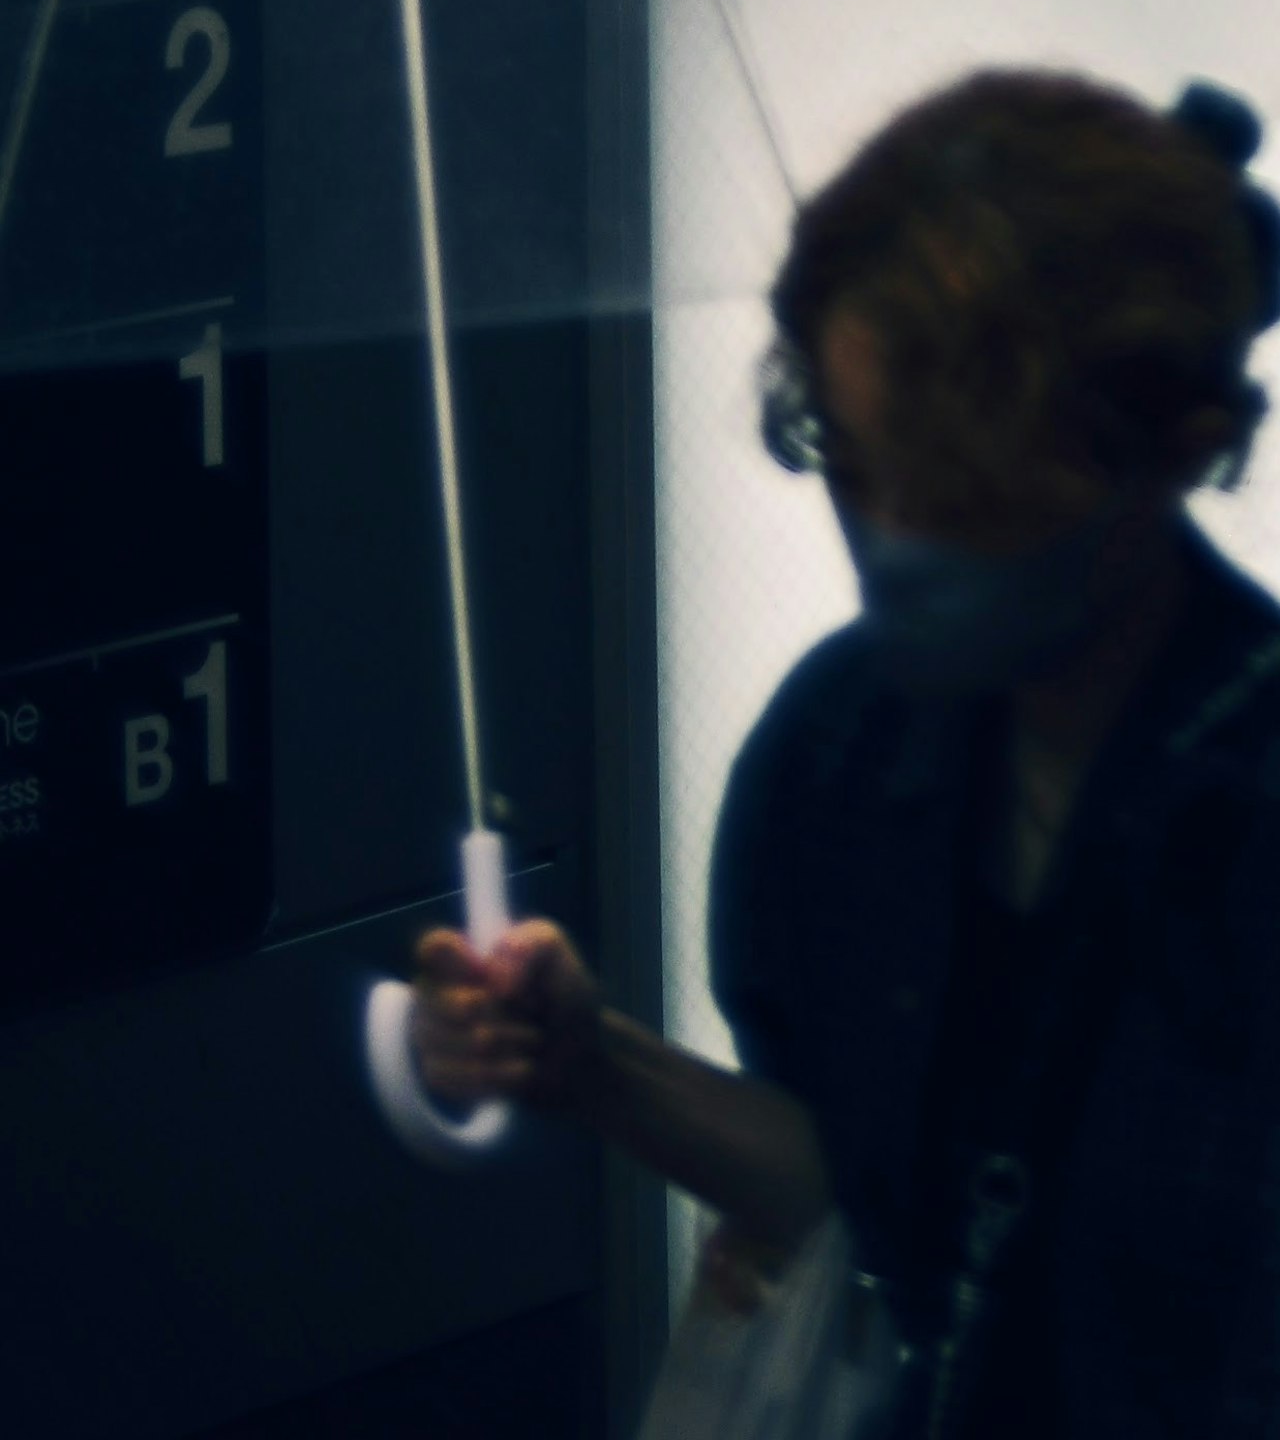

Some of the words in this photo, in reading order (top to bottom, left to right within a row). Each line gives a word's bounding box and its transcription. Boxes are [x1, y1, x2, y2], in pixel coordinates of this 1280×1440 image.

[164, 6, 234, 159] 2
[179, 322, 225, 468] 1
[124, 640, 230, 809] B1
